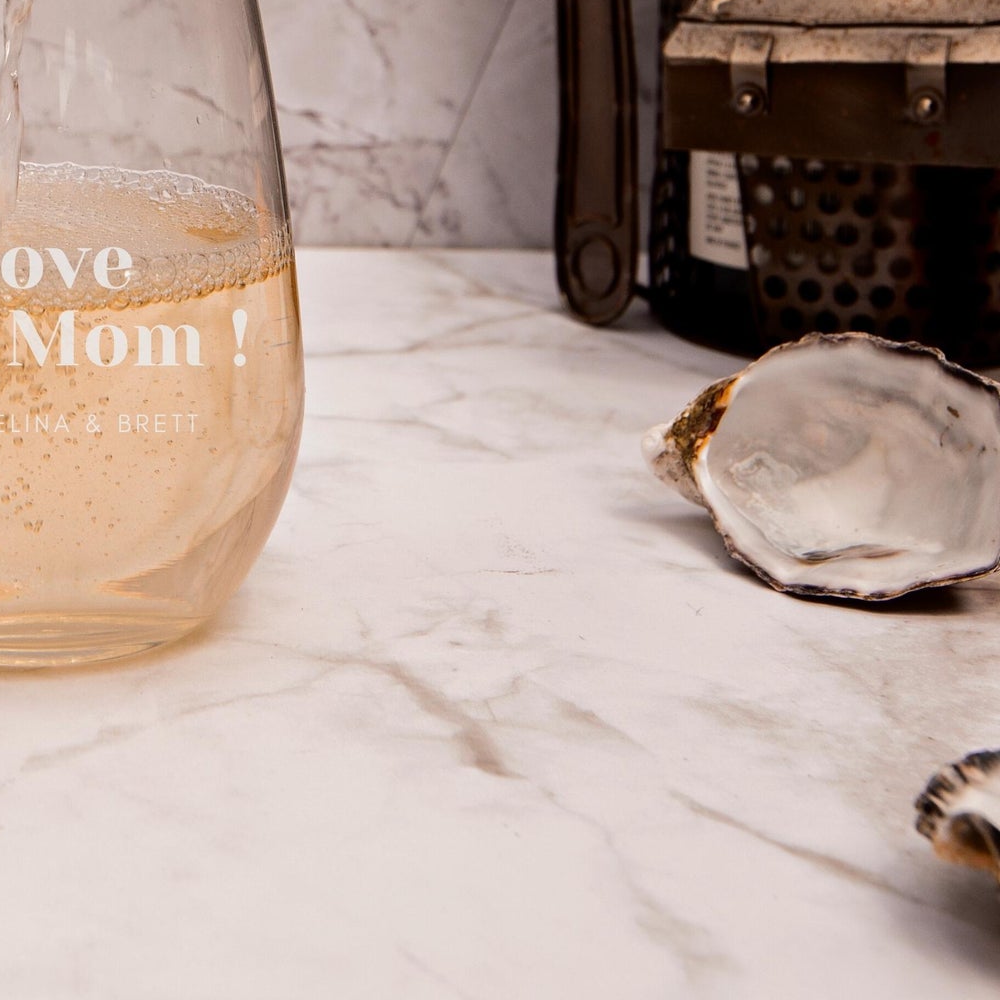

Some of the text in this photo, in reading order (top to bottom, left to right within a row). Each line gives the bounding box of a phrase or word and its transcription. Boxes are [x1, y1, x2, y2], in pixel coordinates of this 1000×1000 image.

[6, 308, 205, 368] Mom
[231, 308, 249, 368] !
[85, 413, 102, 434] &
[118, 413, 200, 434] BRETT
